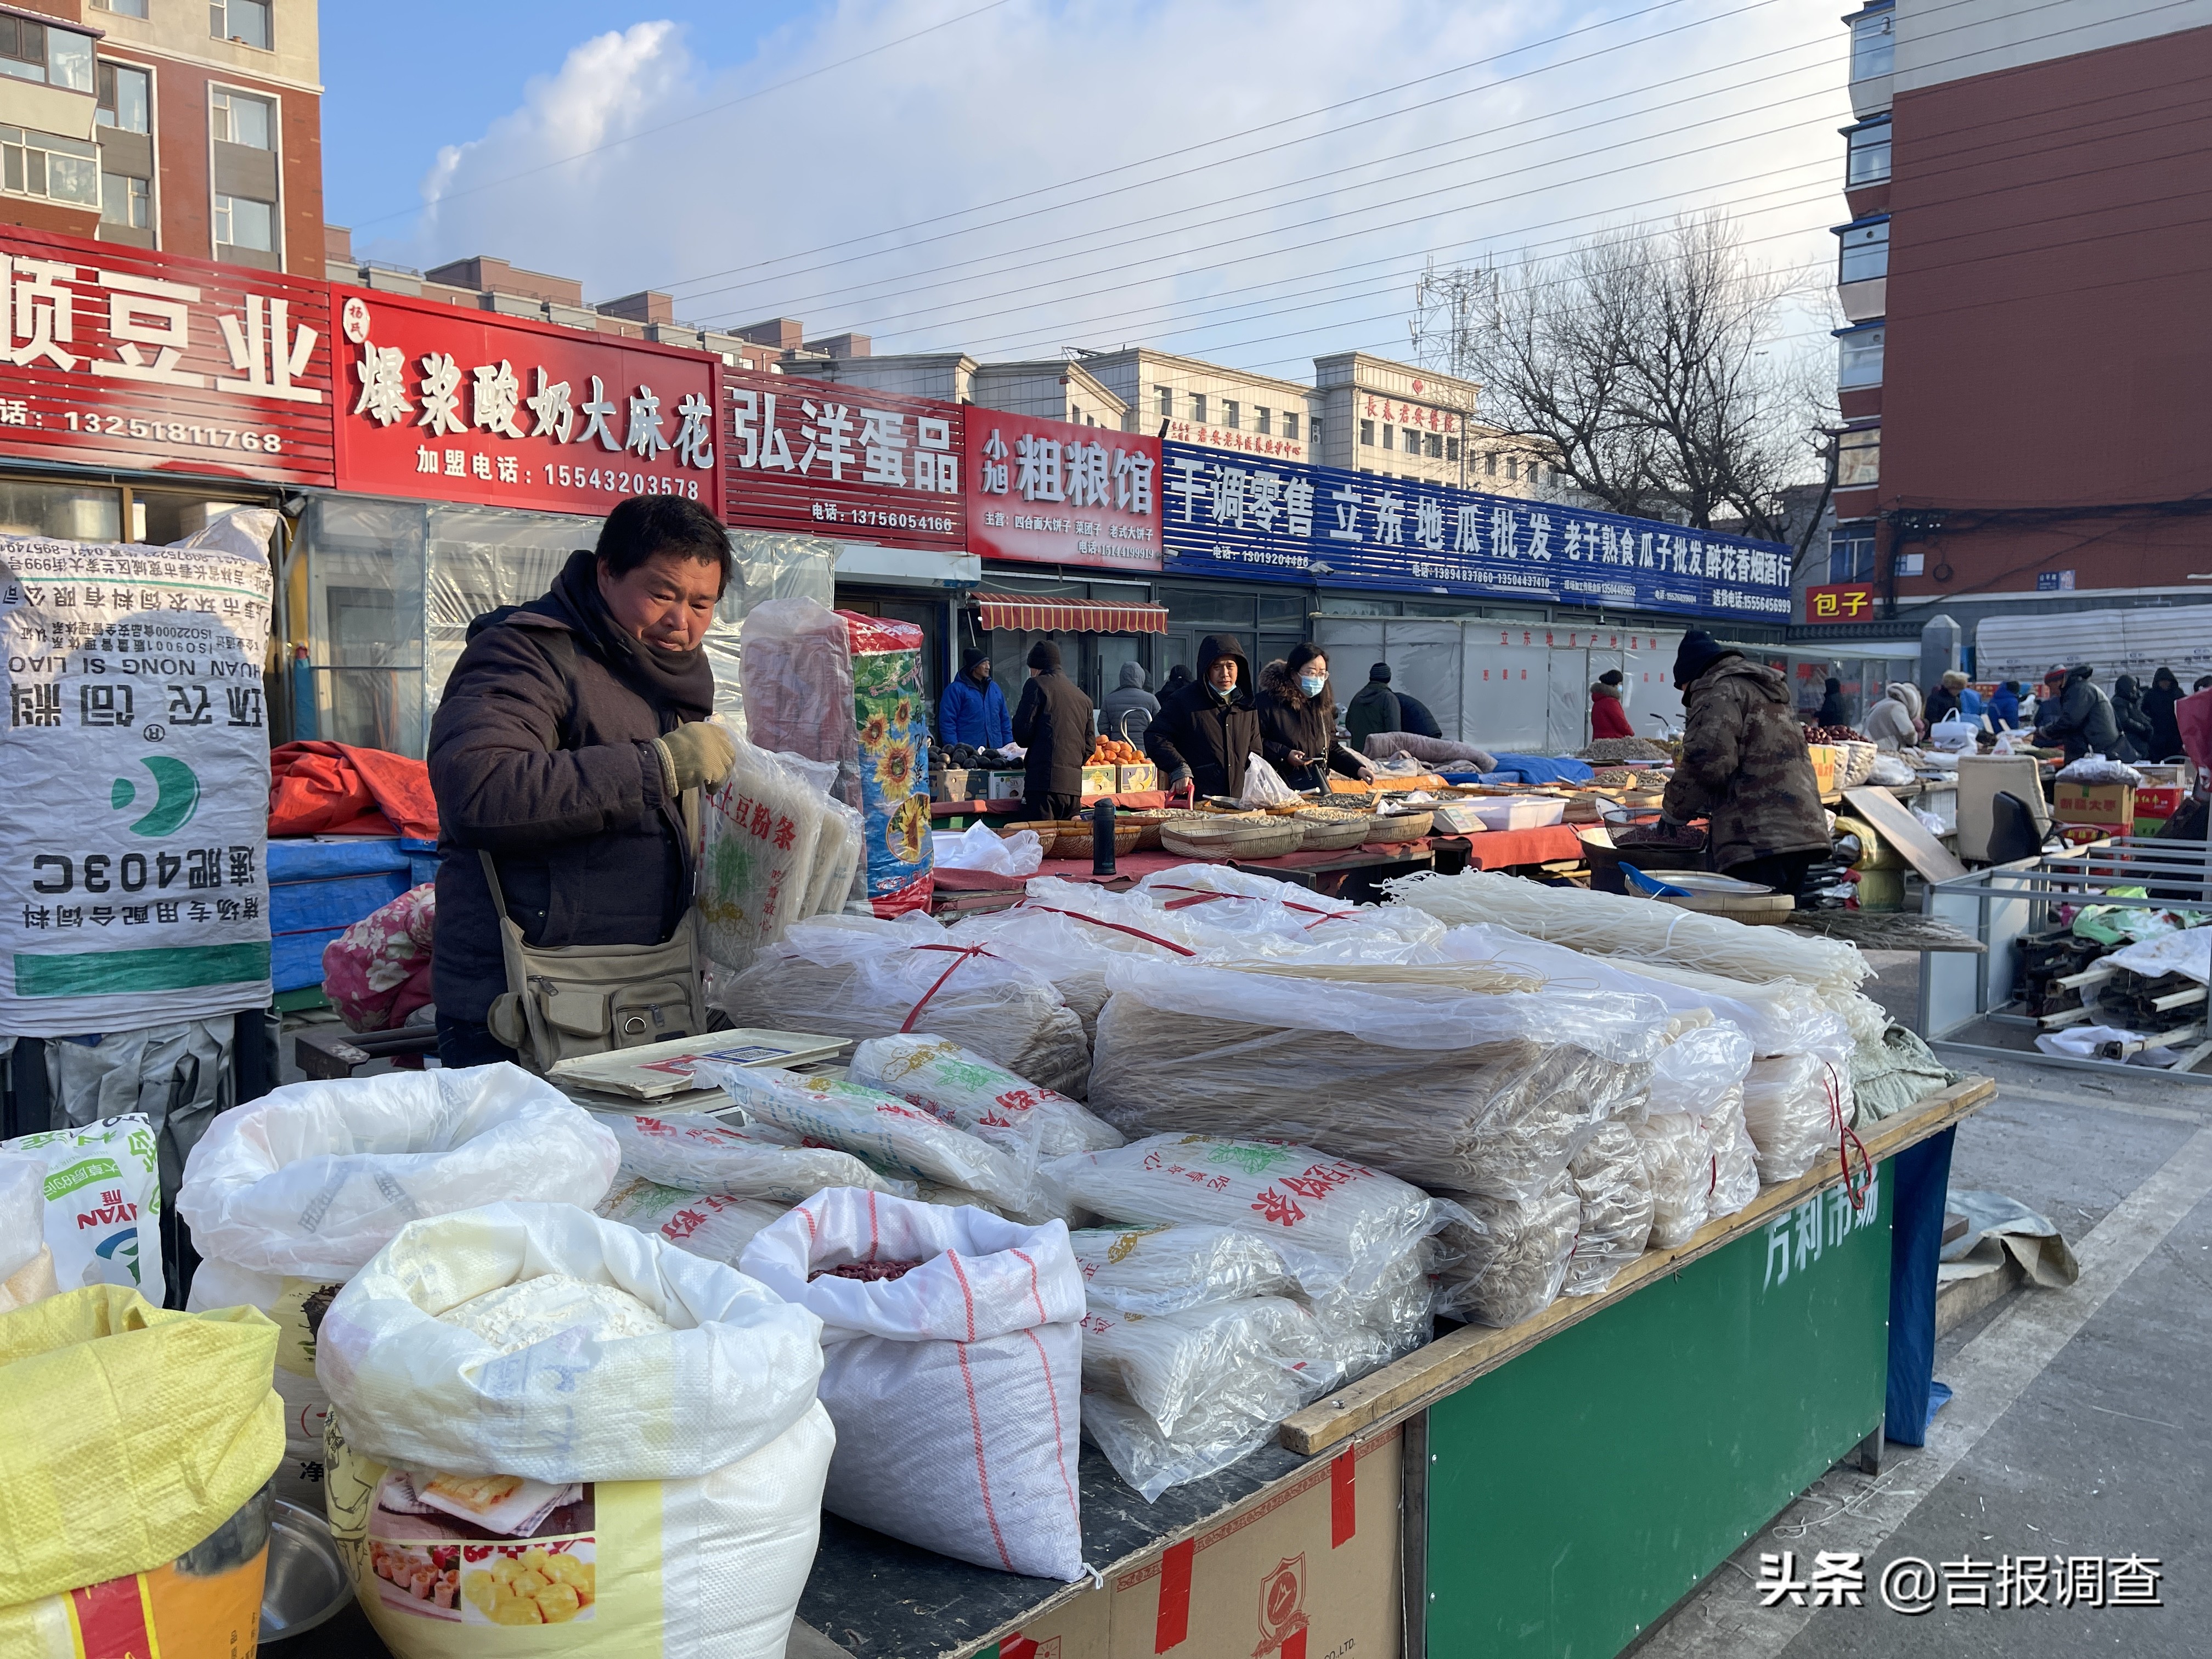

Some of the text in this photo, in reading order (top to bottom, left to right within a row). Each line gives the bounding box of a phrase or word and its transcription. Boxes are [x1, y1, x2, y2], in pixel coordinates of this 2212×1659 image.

[354, 340, 714, 470] 爆浆酸奶大麻花
[733, 388, 960, 495] 弘洋蛋品
[983, 428, 1009, 496] 小旭
[1015, 432, 1156, 516] 粗粮馆
[1170, 456, 1316, 538] 干调零售
[1109, 524, 1154, 541] 老式大饼子
[1329, 483, 1552, 562] 立东地瓜批发
[1639, 531, 1702, 576] 瓜子批发
[1706, 542, 1792, 588] 醉花香烟酒行
[1813, 592, 1868, 617] 包子
[9, 656, 67, 674] LIAO
[83, 657, 106, 675] SI
[122, 658, 195, 676] NONG
[10, 682, 263, 727] 环农饲料
[33, 846, 255, 894] 速肥403C
